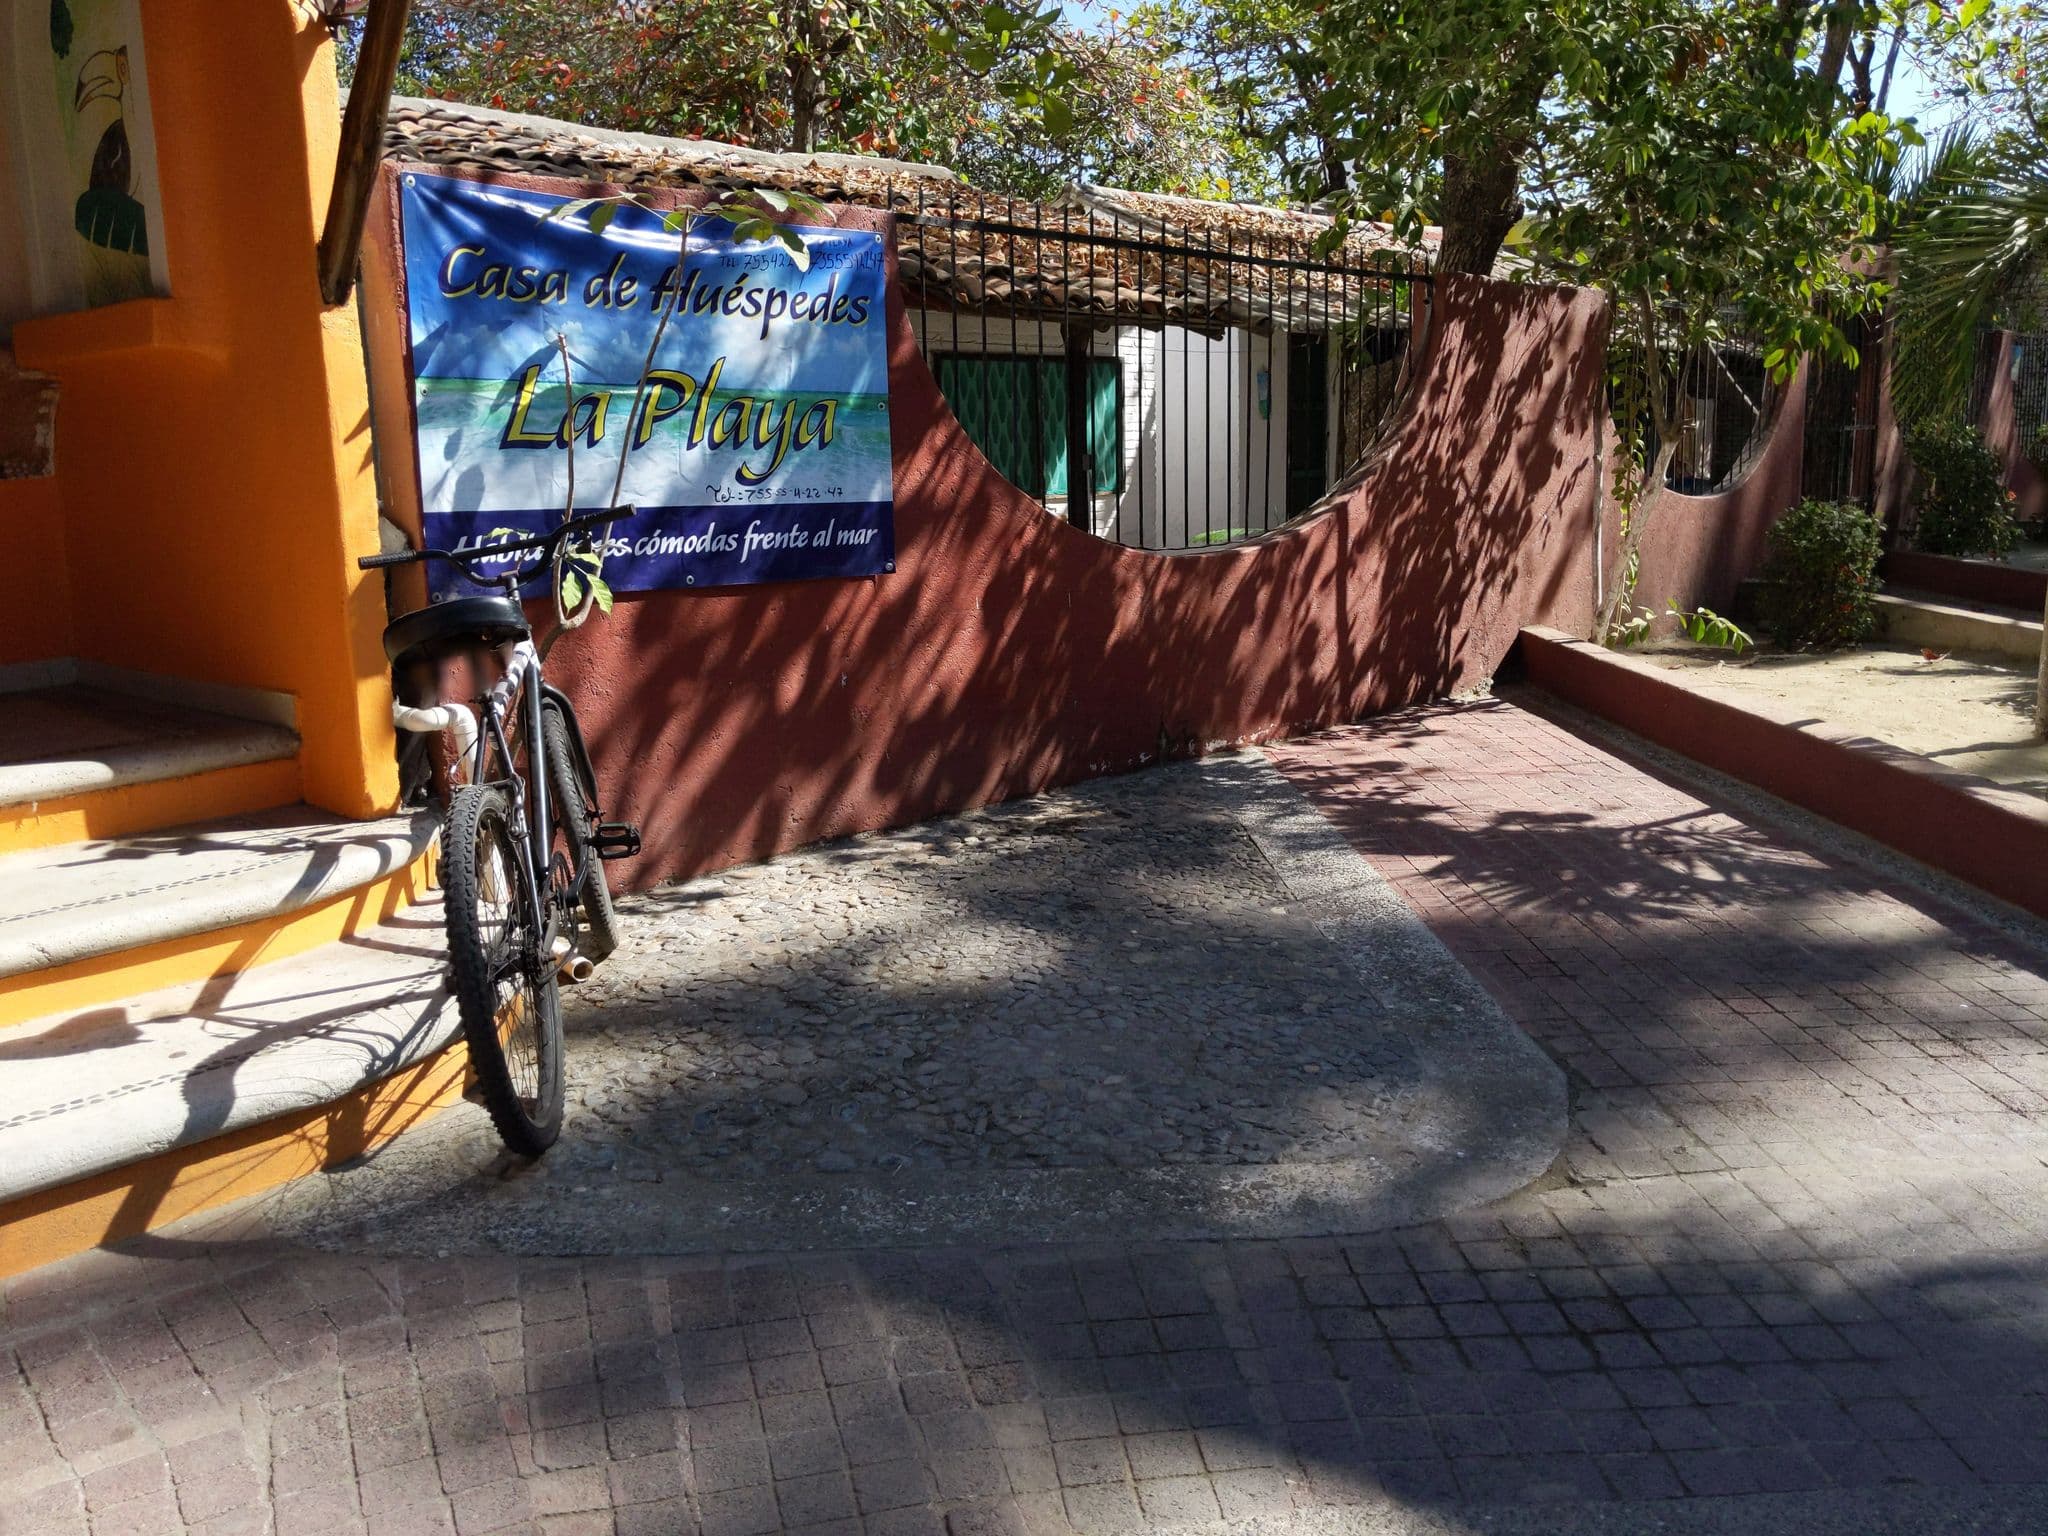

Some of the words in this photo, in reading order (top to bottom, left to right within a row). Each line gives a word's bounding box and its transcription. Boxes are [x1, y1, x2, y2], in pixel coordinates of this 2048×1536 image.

[438, 243, 569, 305] Casa
[582, 251, 639, 310] de
[650, 261, 872, 340] Huéspedes
[498, 362, 613, 451] La
[631, 356, 840, 486] Playa
[633, 522, 738, 556] cómodas
[739, 520, 809, 563] frente
[812, 518, 836, 547] al
[836, 527, 879, 546] mar
